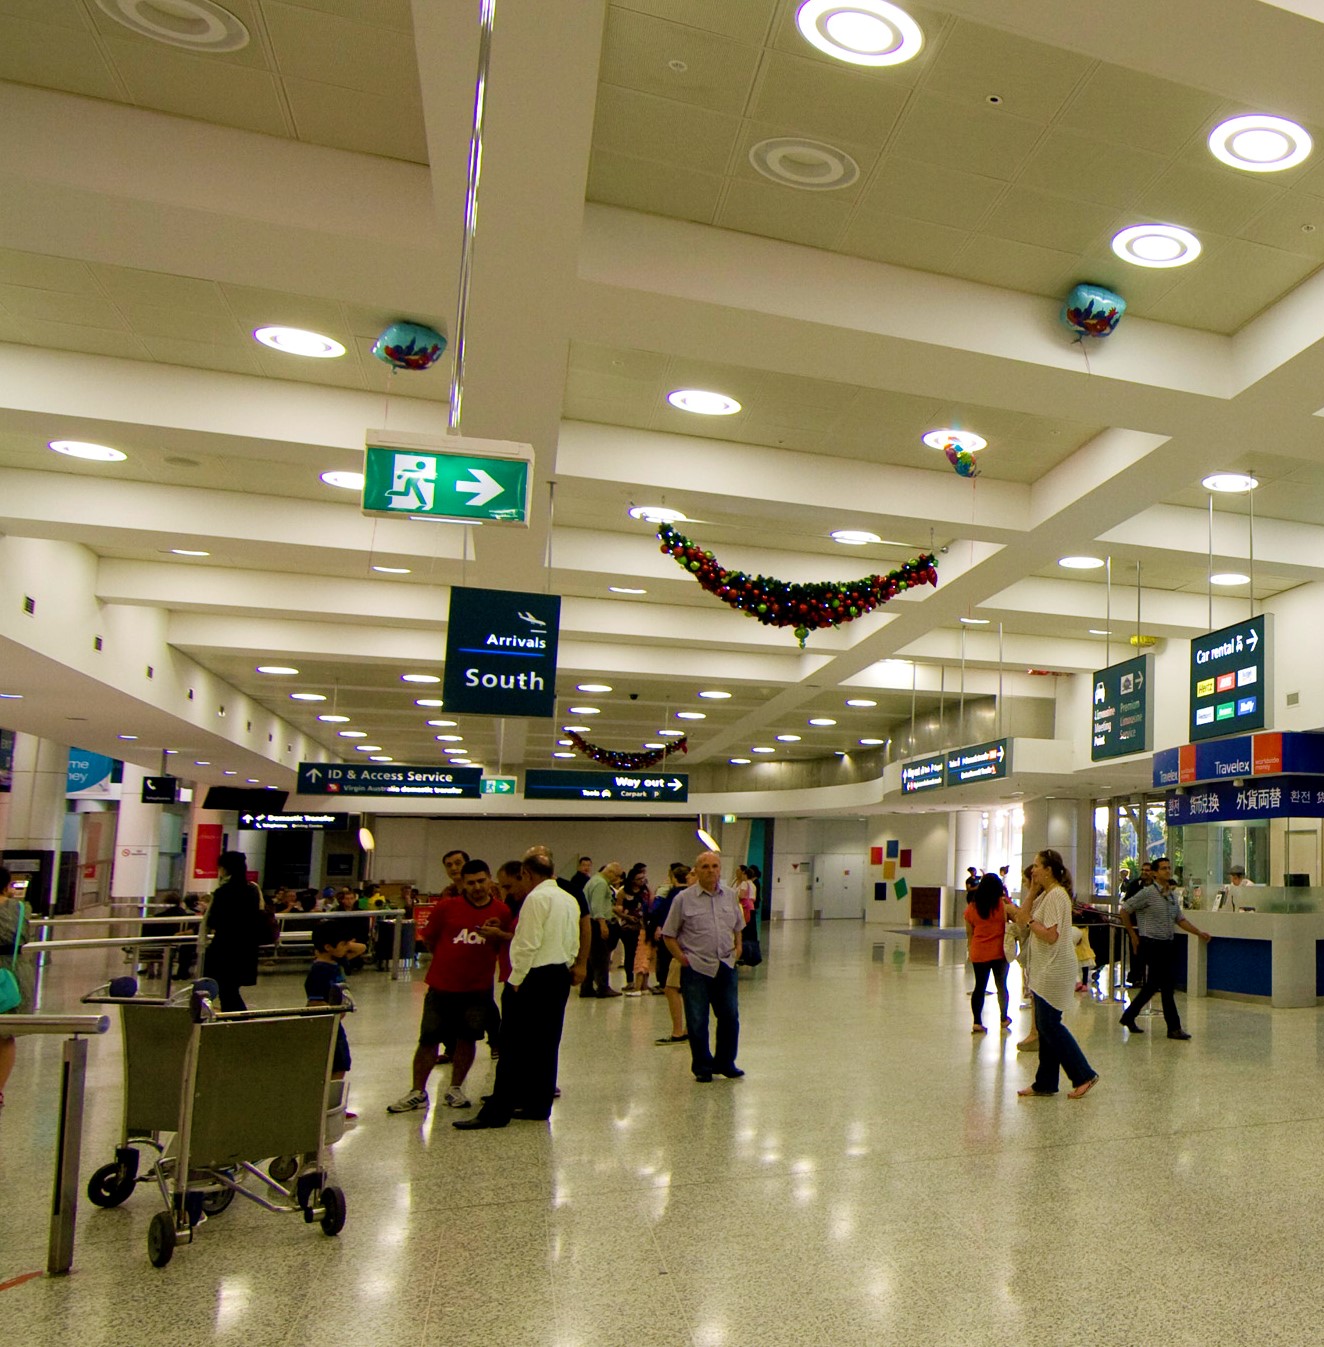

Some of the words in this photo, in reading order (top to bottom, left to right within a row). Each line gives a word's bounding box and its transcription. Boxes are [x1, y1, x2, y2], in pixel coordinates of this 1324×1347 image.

[486, 634, 547, 649] Arrivals
[1196, 649, 1210, 664] Car
[1211, 638, 1235, 659] rental
[465, 668, 545, 691] South
[1214, 759, 1250, 775] Travelex
[328, 769, 342, 779] ID
[346, 770, 357, 779] &
[361, 770, 403, 781] Access
[407, 771, 453, 782] Service
[615, 776, 640, 789] Way
[643, 778, 665, 788] out
[1160, 770, 1178, 783] Travelex
[343, 785, 365, 793] Virgin
[1236, 787, 1282, 811] 外貨両替
[1290, 790, 1311, 804] 환전
